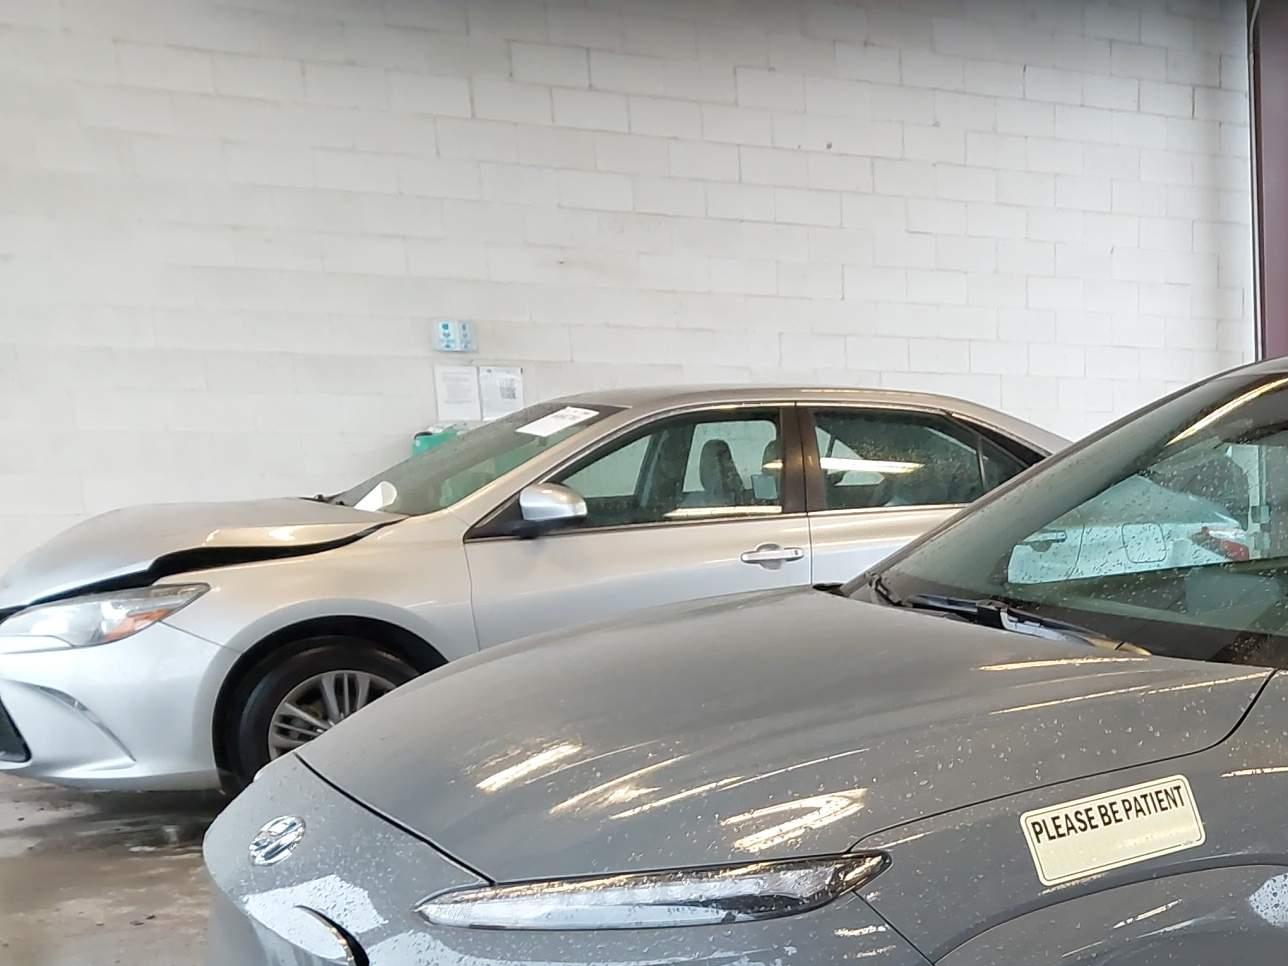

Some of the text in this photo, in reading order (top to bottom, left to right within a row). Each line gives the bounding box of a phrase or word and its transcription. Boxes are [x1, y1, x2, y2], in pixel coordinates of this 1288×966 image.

[1031, 785, 1185, 844] PLEASE BE PATIENT
